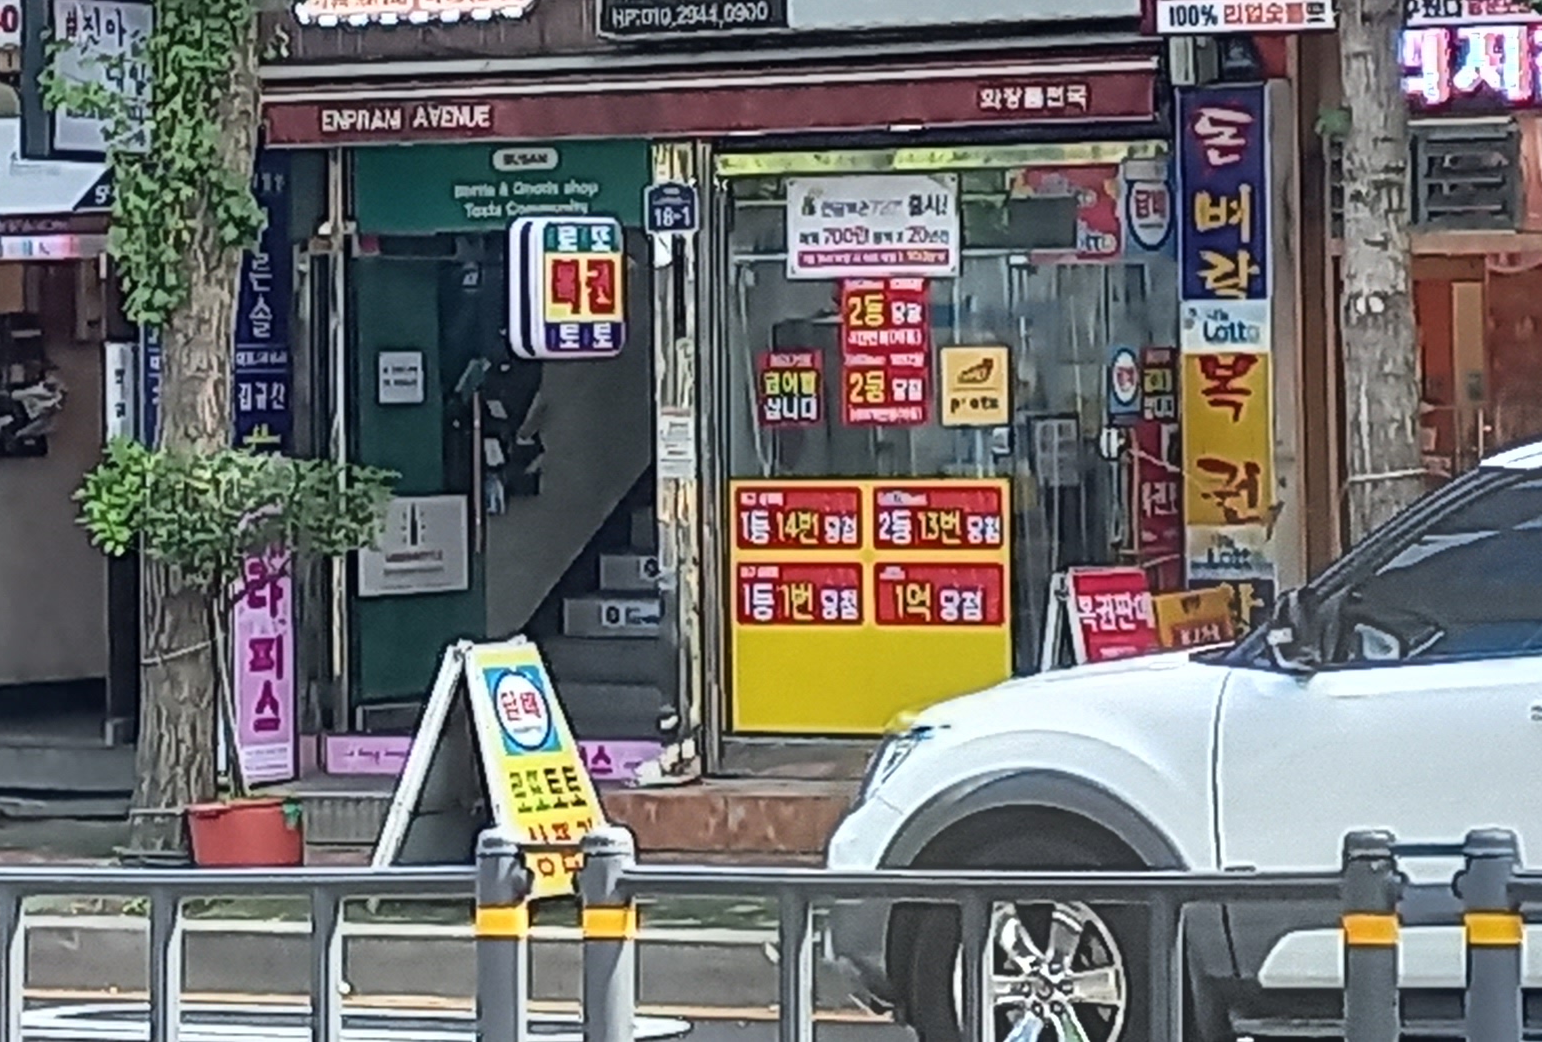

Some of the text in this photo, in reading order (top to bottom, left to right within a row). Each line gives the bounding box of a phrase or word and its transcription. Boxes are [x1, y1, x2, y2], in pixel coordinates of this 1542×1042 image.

[1168, 4, 1219, 27] 100%
[412, 104, 492, 129] AVENUE
[653, 206, 692, 228] 18-1
